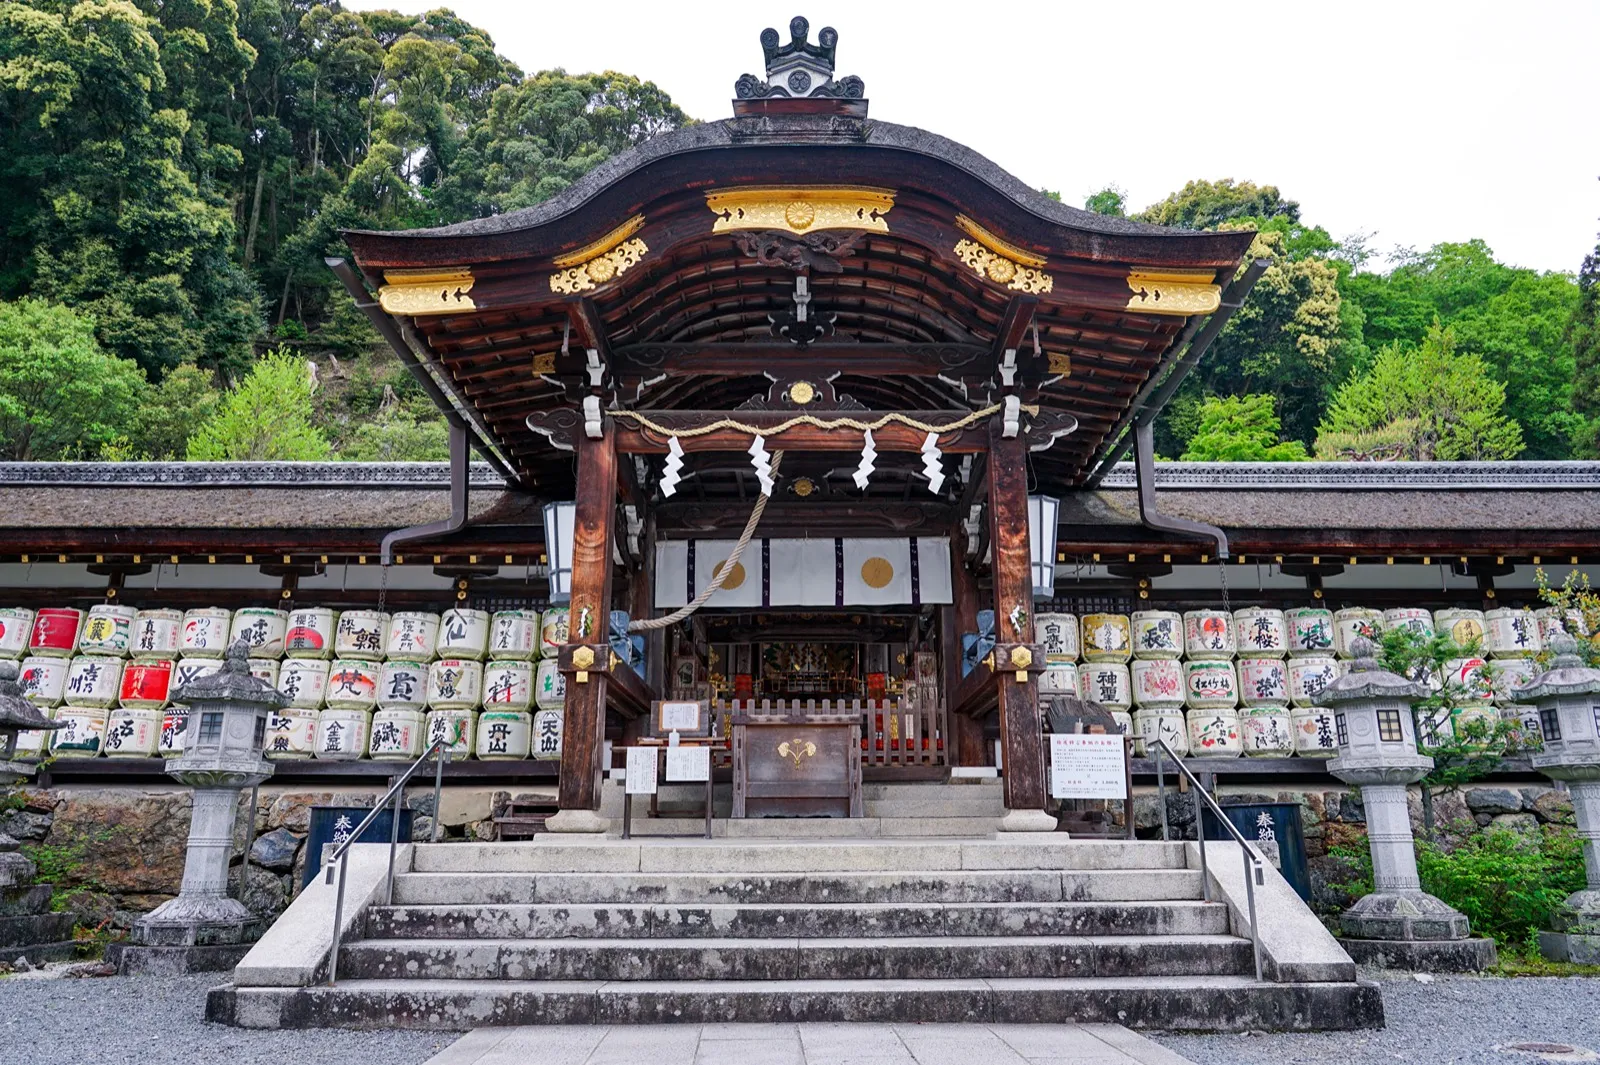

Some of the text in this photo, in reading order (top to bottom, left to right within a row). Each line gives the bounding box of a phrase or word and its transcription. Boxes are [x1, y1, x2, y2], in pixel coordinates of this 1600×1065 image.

[89, 617, 106, 641] 一本義
[140, 619, 156, 651] 真鶴
[294, 614, 306, 648] 櫻正宗
[339, 619, 381, 651] 酔鯨
[1044, 623, 1064, 654] 白鷹
[1254, 617, 1276, 649] 黄桜
[335, 669, 362, 696] 梵
[1096, 670, 1120, 703] 神聖
[1195, 677, 1230, 690] 松竹梅
[106, 719, 135, 749] 五橋
[488, 723, 512, 753] 丹山
[541, 720, 559, 752] 天山
[1256, 812, 1276, 841] 奉納
